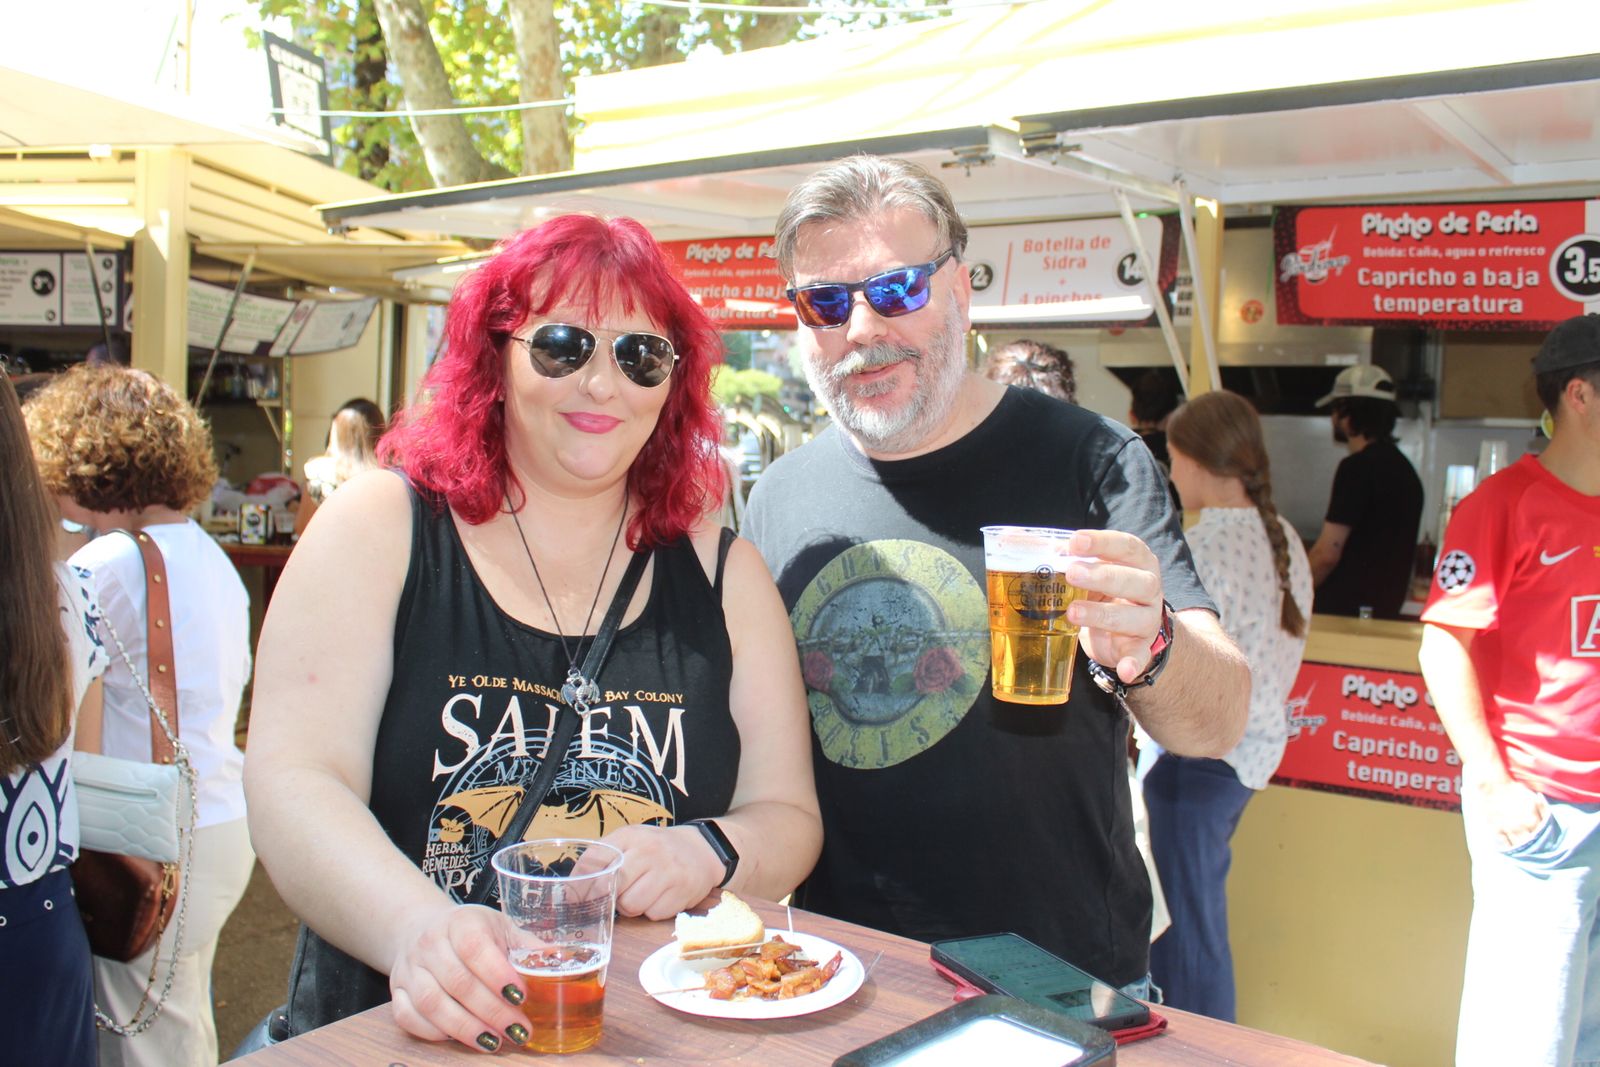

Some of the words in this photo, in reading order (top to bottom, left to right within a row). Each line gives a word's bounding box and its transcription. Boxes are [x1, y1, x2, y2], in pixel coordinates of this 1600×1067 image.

[1361, 211, 1433, 240] Pincho
[1438, 210, 1471, 234] de
[1475, 208, 1539, 234] Feria
[686, 243, 731, 264] Pincho
[735, 243, 755, 259] de
[1023, 237, 1085, 253] Botella
[1090, 235, 1112, 250] de
[1445, 247, 1476, 260] agua
[1478, 248, 1486, 257] o
[1488, 245, 1546, 257] refresco
[1042, 254, 1087, 271] Sidra
[1357, 266, 1457, 290] Capricho
[1462, 270, 1478, 287] a
[1483, 266, 1541, 291] baja
[1373, 294, 1524, 316] temperatura
[449, 674, 467, 689] YE
[471, 674, 508, 689] OLDE
[604, 689, 630, 703] BAY
[633, 689, 684, 704] COLONY
[1341, 674, 1419, 710] Pincho
[1332, 729, 1439, 763] Capricho
[425, 842, 471, 858] HERBAL
[422, 854, 472, 874] REMEDIES
